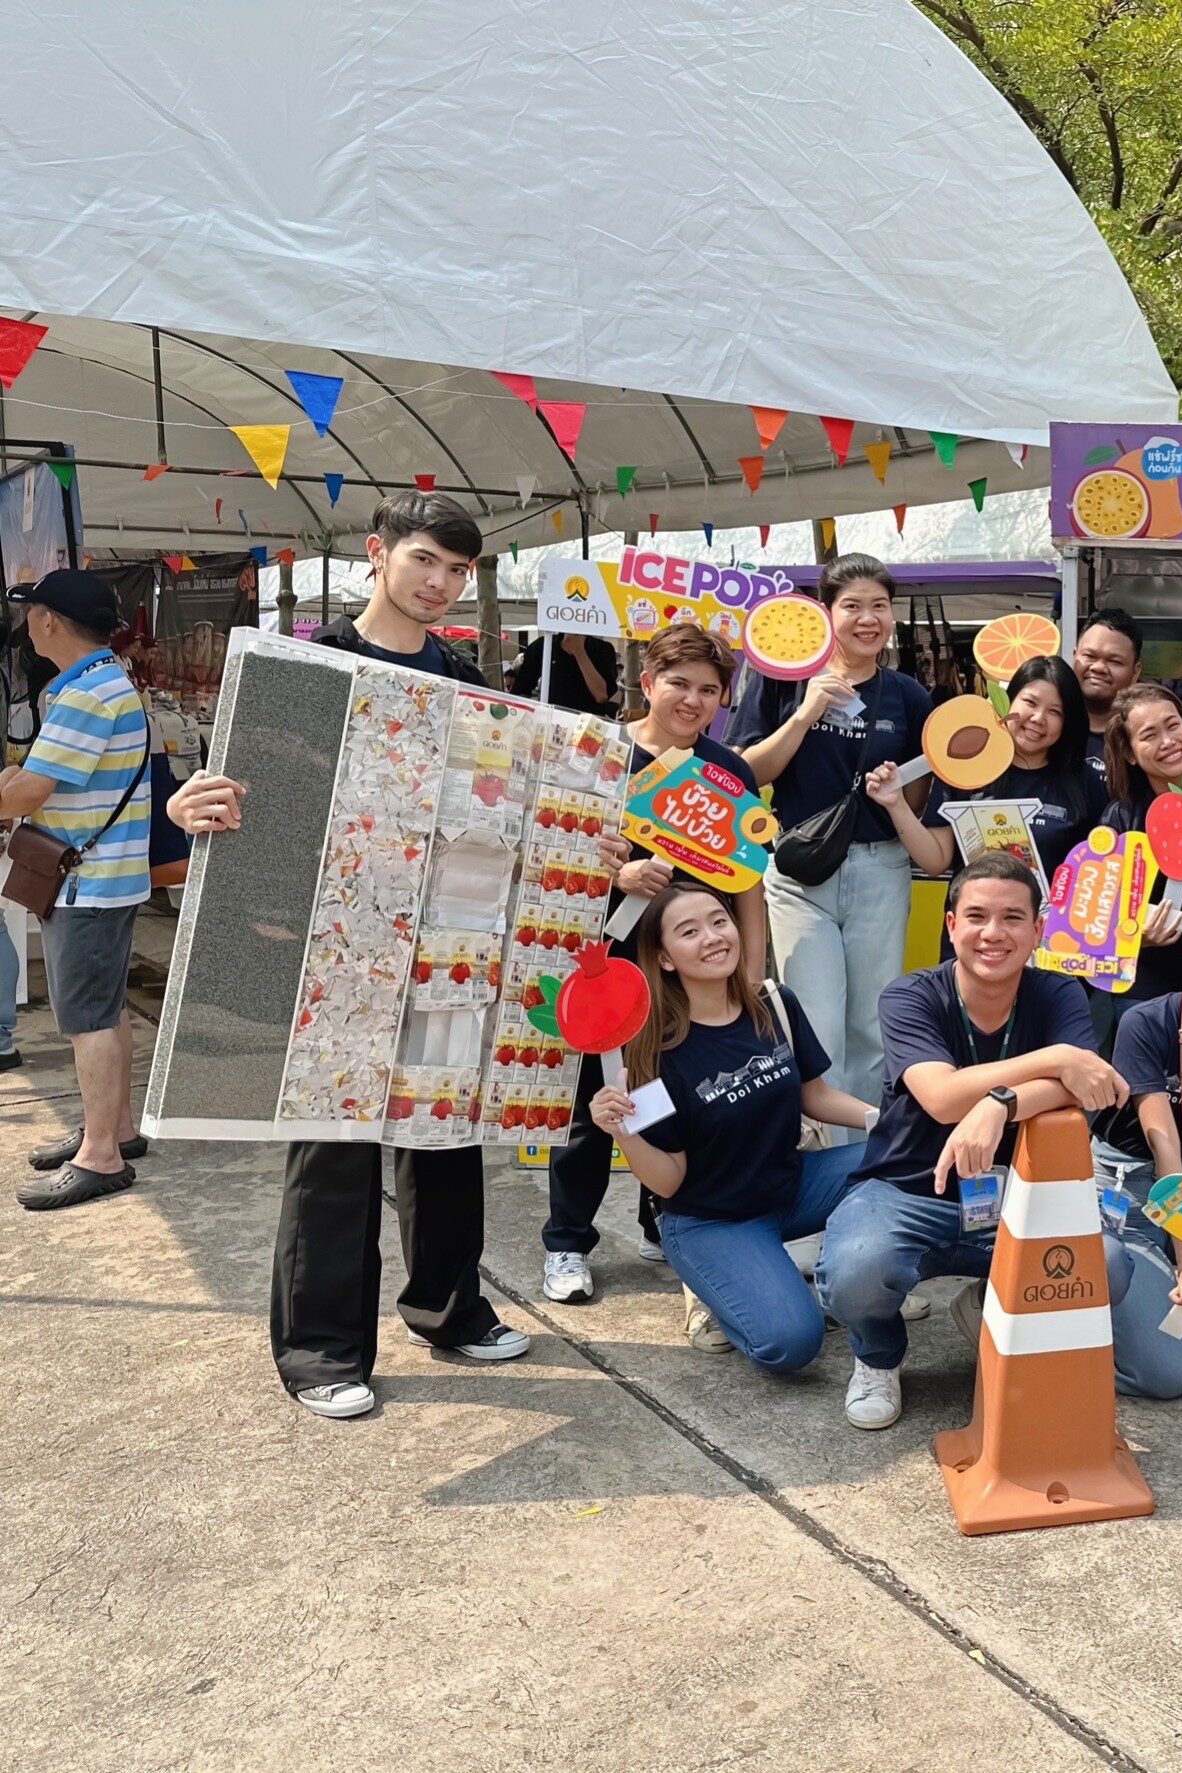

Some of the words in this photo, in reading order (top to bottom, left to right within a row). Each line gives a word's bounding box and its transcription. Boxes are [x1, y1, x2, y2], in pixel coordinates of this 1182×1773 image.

[620, 547, 690, 596] ICE
[546, 604, 607, 625] ดอยคำ
[705, 765, 742, 794] ไอซ์ป๊อป
[682, 782, 729, 820] บ๊วย
[662, 795, 726, 850] ไม่บ๊วย
[727, 1084, 751, 1104] Doi
[753, 1065, 791, 1089] Kham
[1023, 1276, 1094, 1303] ดอยคำ
